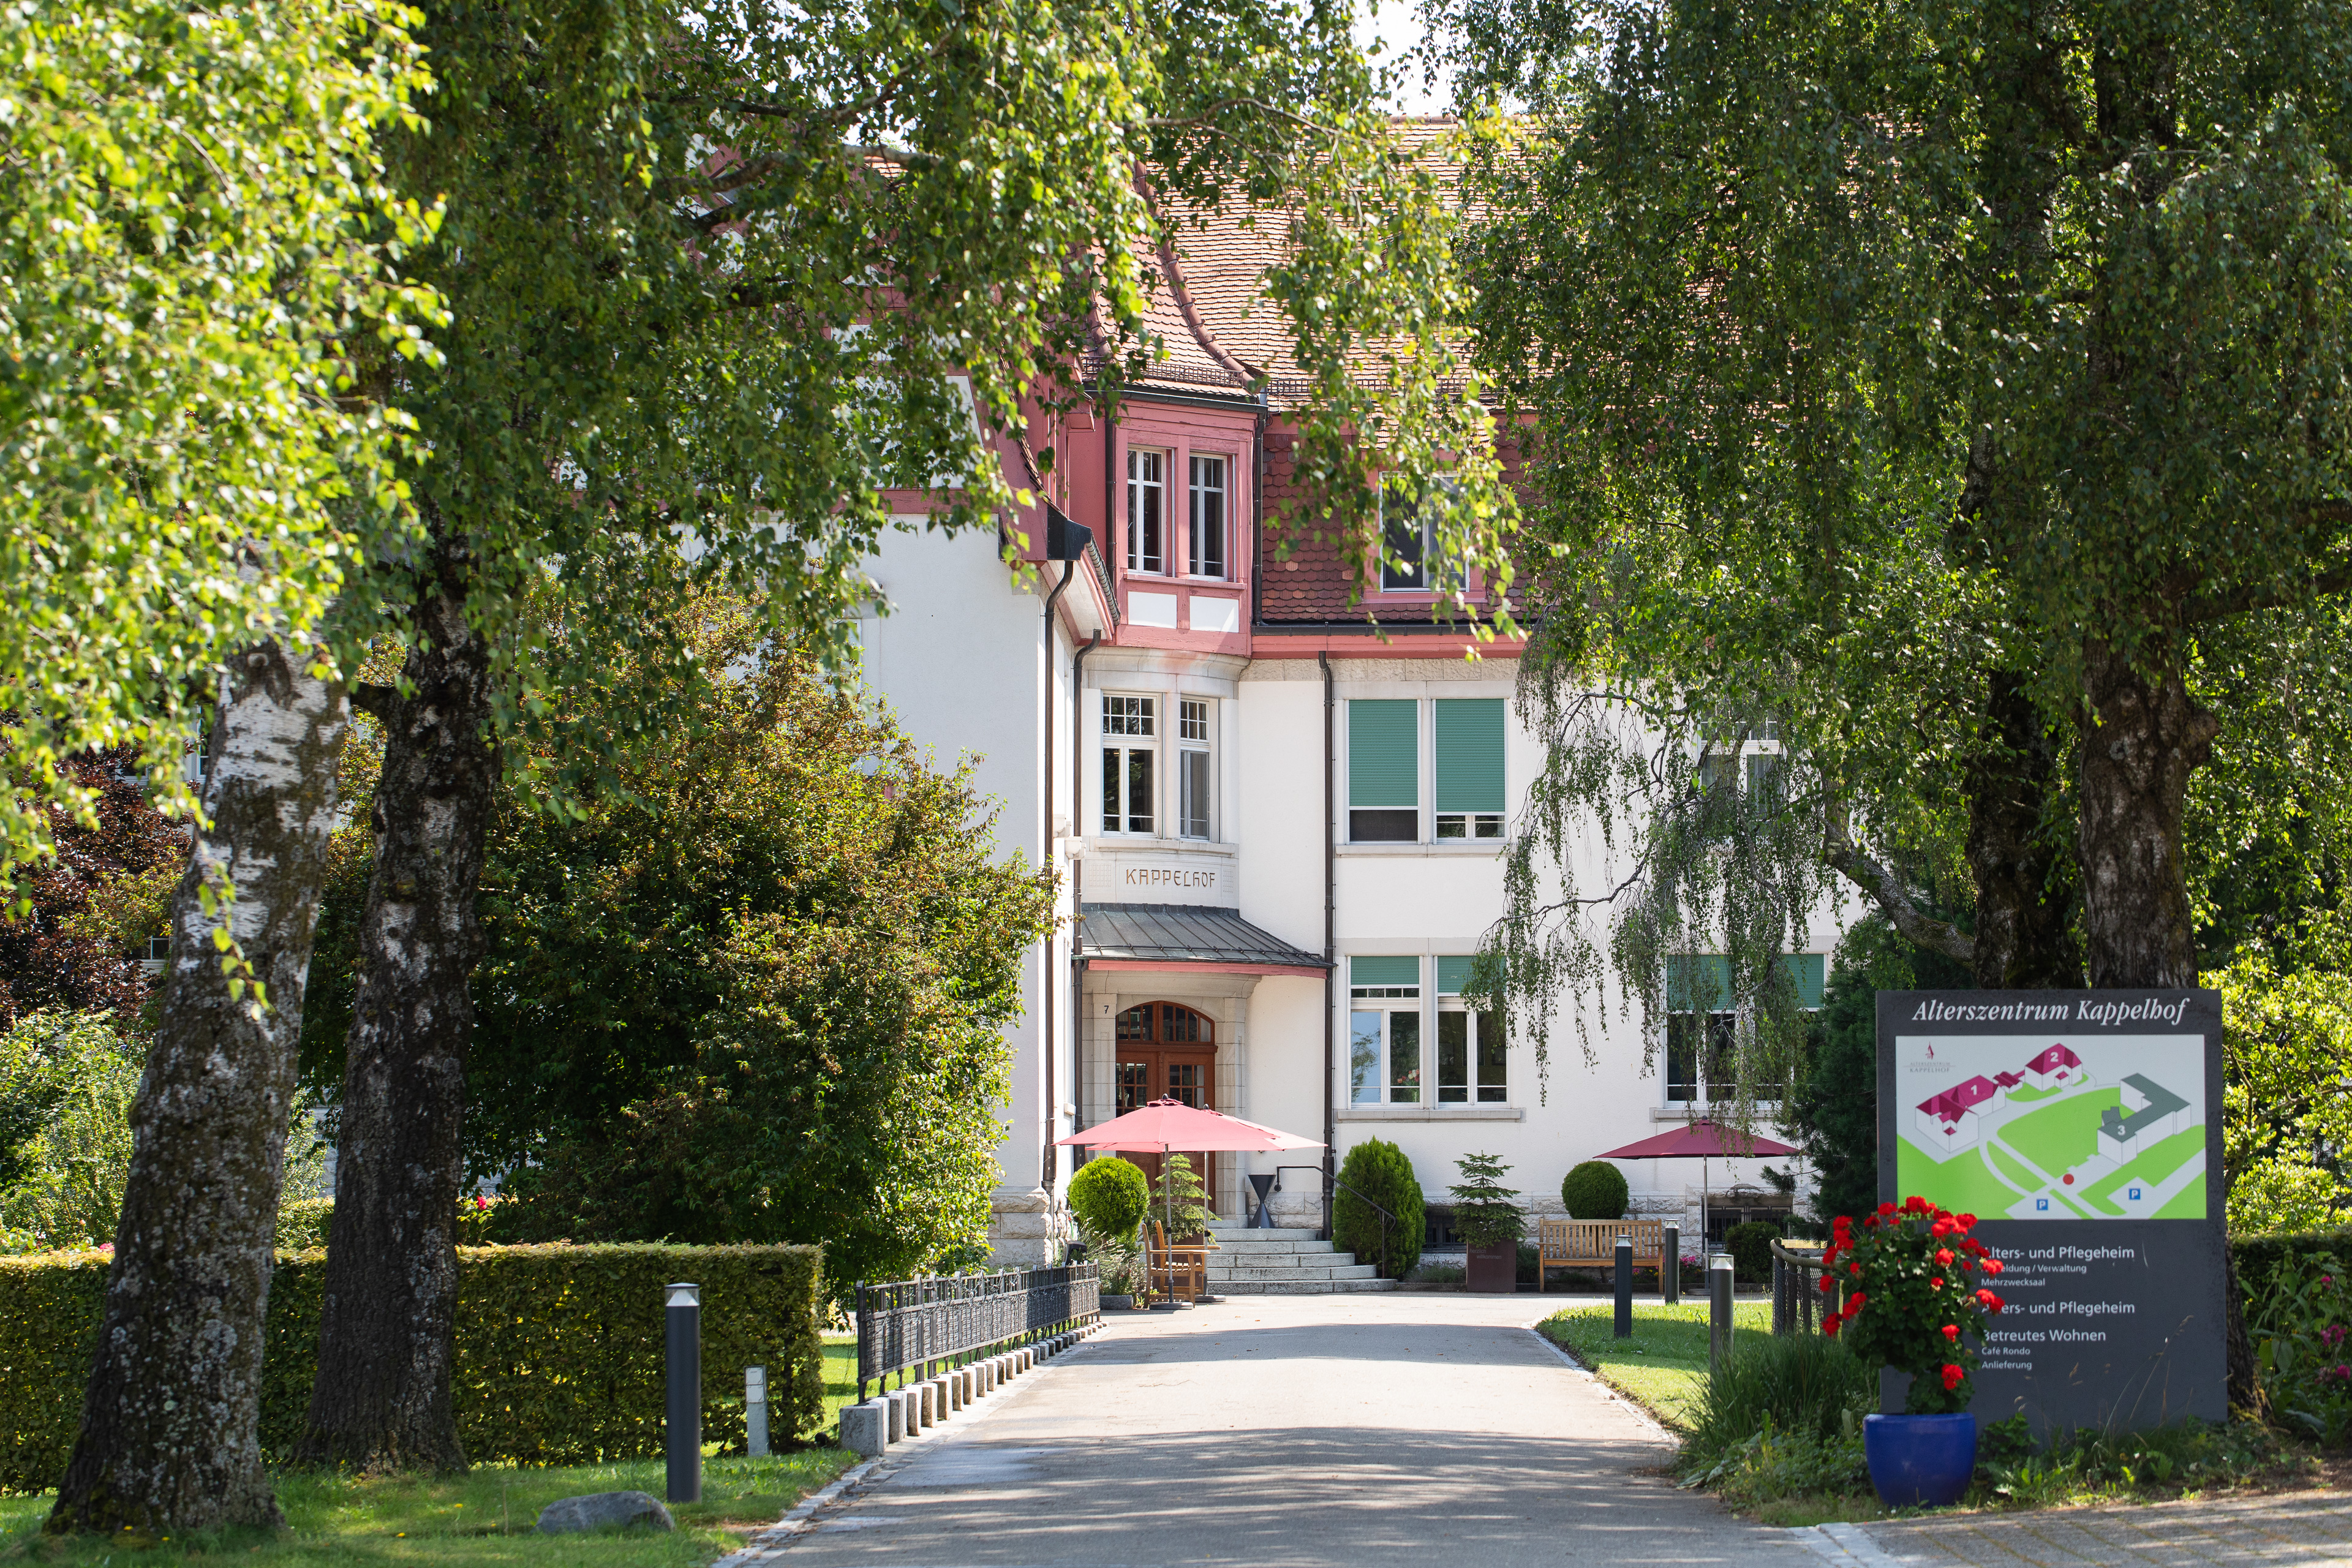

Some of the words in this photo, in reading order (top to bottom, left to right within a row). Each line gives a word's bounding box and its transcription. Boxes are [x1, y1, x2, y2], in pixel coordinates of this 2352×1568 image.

[1126, 869, 1216, 888] KAPPELHOF
[1104, 1005, 1109, 1014] 7
[1912, 1000, 2069, 1021] Alterszentrum
[2076, 998, 2190, 1026] Kappelhof
[2050, 1052, 2059, 1063] 2
[1970, 1084, 1978, 1096] 1
[2117, 1125, 2126, 1136] 3
[1985, 1246, 2026, 1259] lters-
[2029, 1245, 2055, 1259] und
[2059, 1245, 2135, 1262] Pflegeheim
[2037, 1264, 2087, 1275] Verwaltung
[1981, 1278, 2046, 1287] Mehrzwecksaal
[2029, 1300, 2056, 1314] und
[2059, 1300, 2136, 1317] Pflegeheim
[2049, 1328, 2106, 1342] Wohnen
[1981, 1346, 2001, 1355] Café
[2003, 1346, 2030, 1355] Rondo
[1981, 1360, 2033, 1371] Anlieferung
